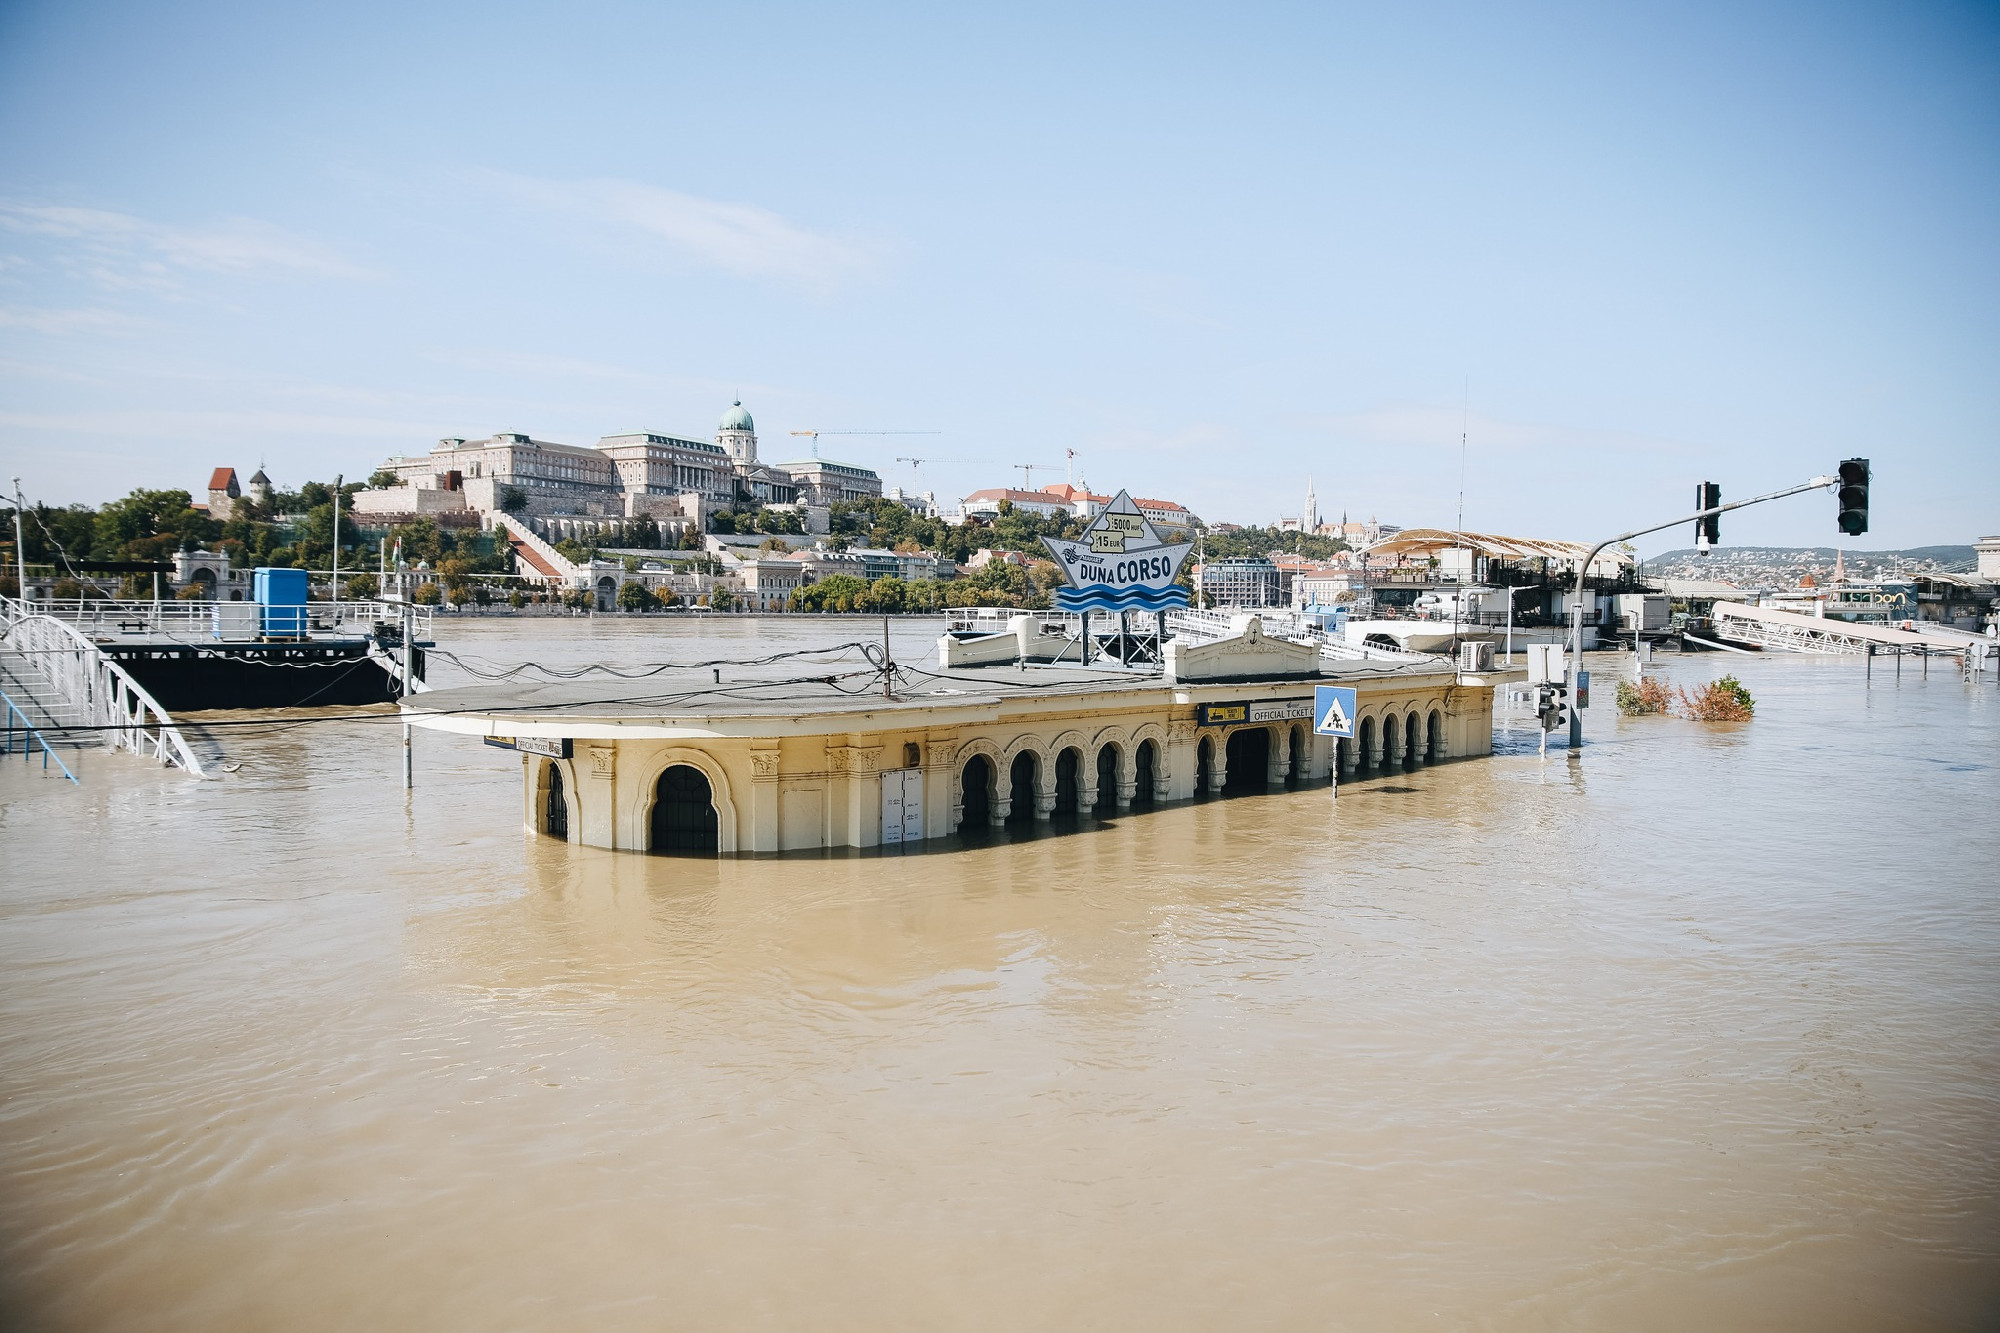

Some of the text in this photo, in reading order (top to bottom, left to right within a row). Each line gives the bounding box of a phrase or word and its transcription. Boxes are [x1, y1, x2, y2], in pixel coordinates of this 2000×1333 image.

[1113, 519, 1130, 530] 5000
[1098, 535, 1121, 548] 15 EUR
[1081, 556, 1170, 584] DUNA CORSO
[1254, 711, 1285, 720] OFFICIAL
[1287, 709, 1308, 717] TCKET
